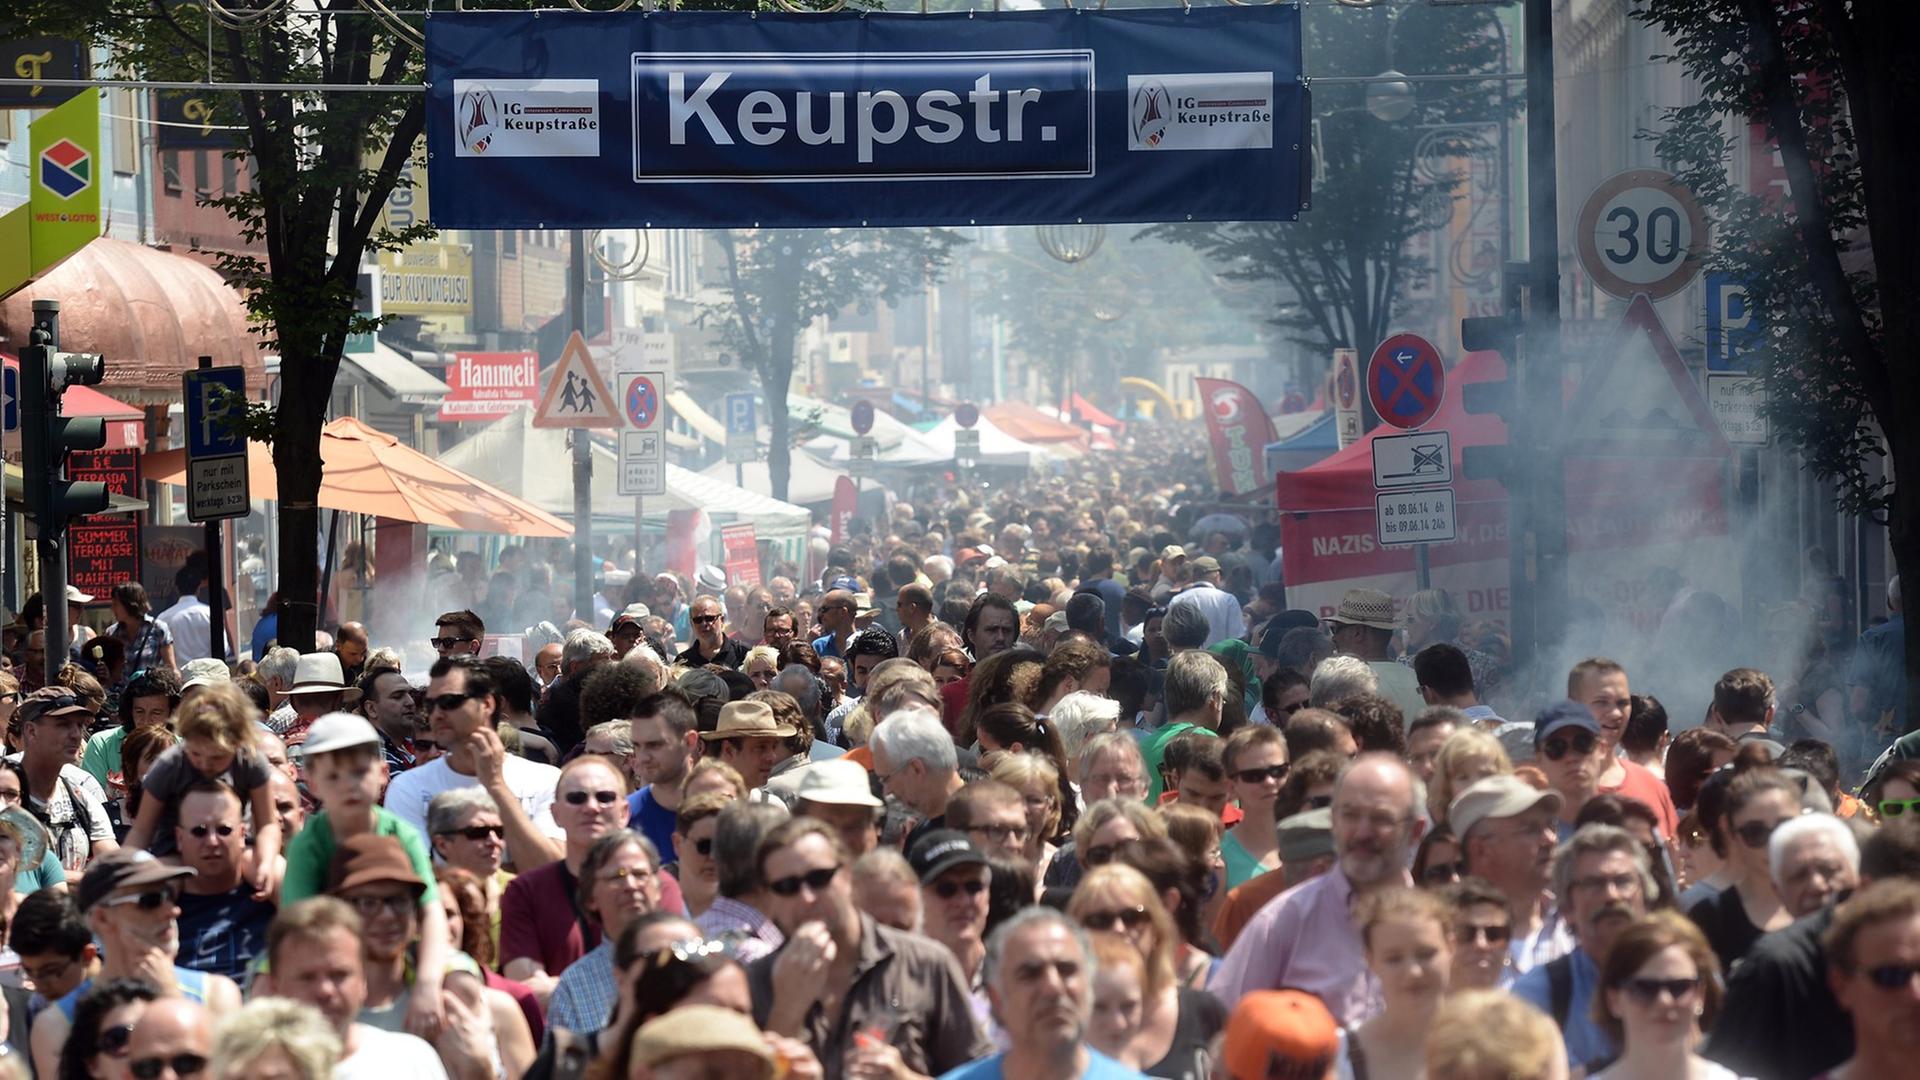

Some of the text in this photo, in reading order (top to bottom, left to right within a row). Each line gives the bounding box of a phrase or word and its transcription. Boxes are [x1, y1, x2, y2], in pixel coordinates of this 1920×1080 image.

[504, 103, 521, 115] IG
[1178, 97, 1195, 109] IG
[505, 117, 597, 133] Keupstraße
[667, 72, 1057, 163] Keupstr.
[1178, 109, 1271, 126] Keupstraße
[36, 213, 97, 223] WEST LOTTO
[1605, 206, 1681, 265] 30
[405, 275, 469, 303] KUYUMCUSU
[1719, 284, 1753, 359] P
[201, 382, 232, 446] P
[203, 464, 234, 478] nur mit
[196, 479, 242, 492] Parkschein
[1385, 501, 1445, 516] ab 08.06.14 6h
[1385, 518, 1446, 533] bis 09.06.14 24h
[77, 530, 129, 543] SOMMER
[74, 543, 132, 557] TERRASSE
[1312, 534, 1375, 557] NAZIS
[90, 559, 114, 570] MIT
[1468, 588, 1510, 612] DIE
